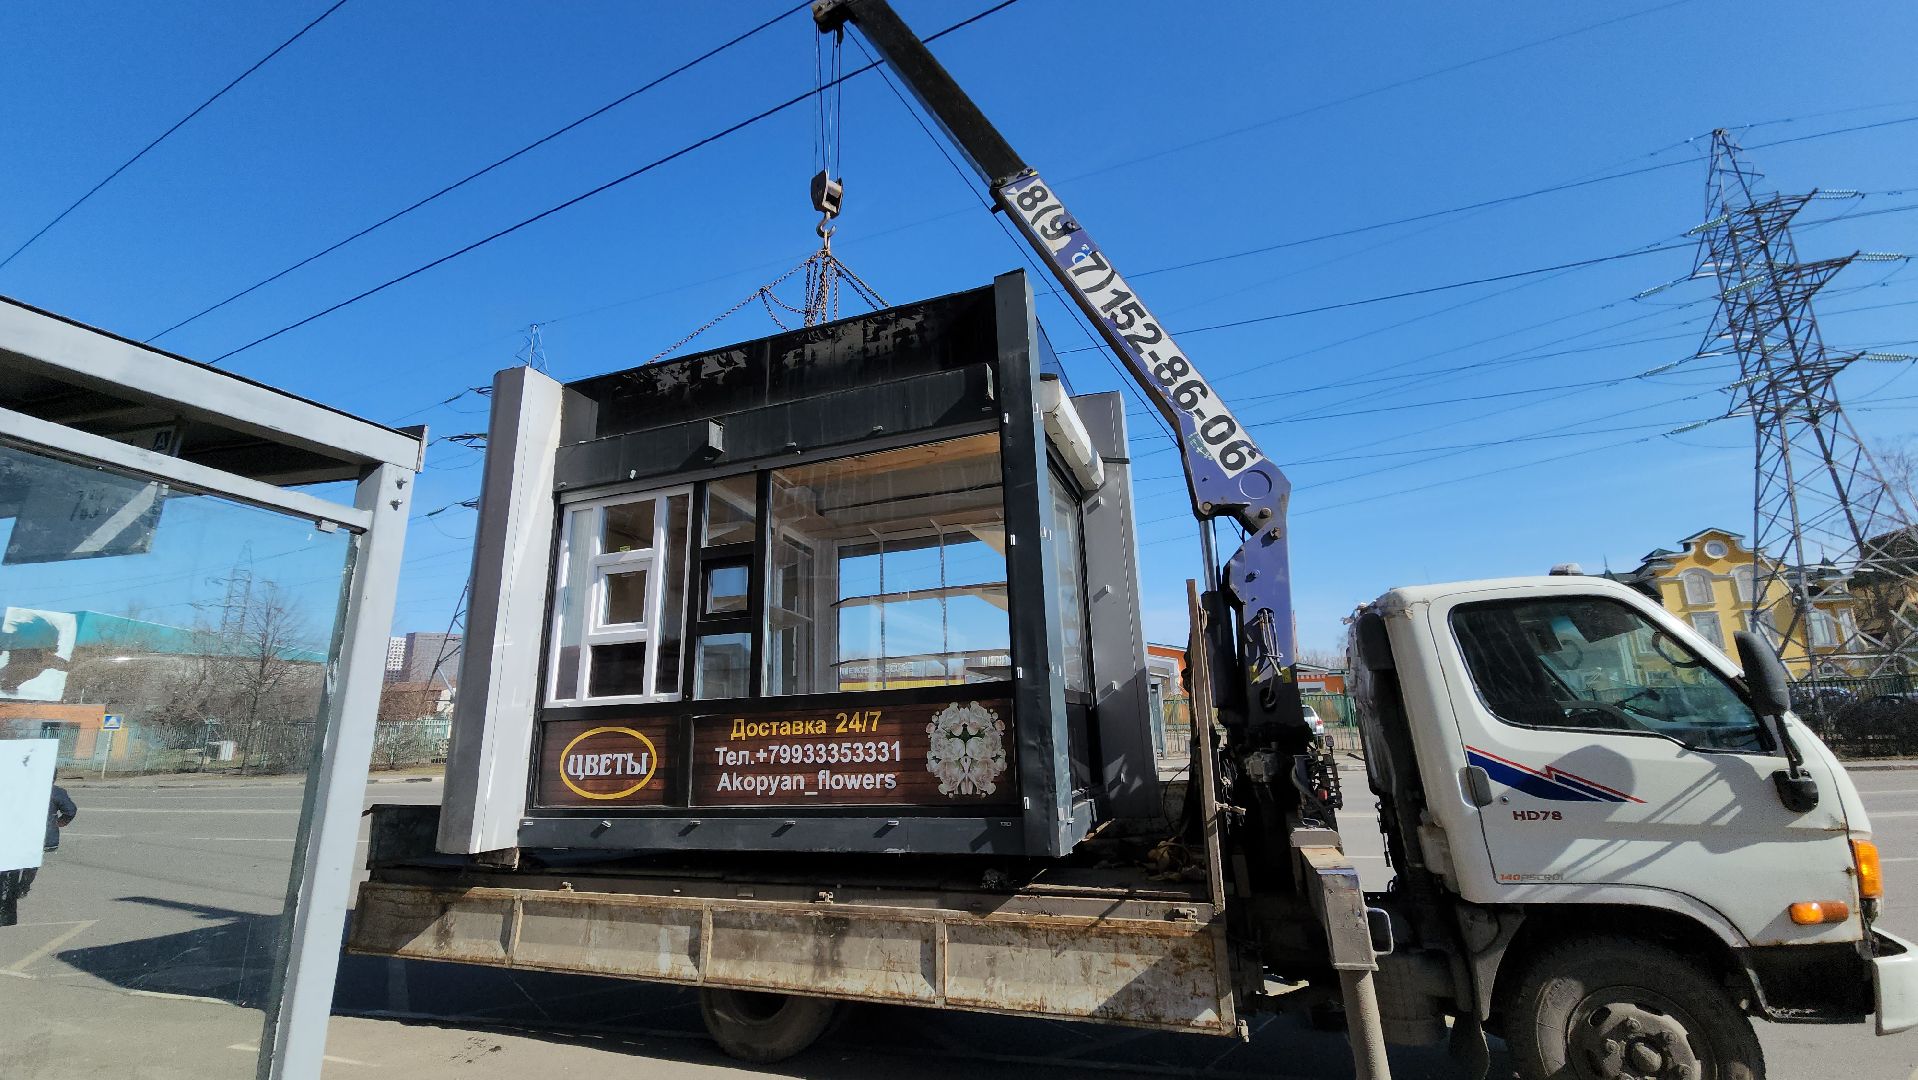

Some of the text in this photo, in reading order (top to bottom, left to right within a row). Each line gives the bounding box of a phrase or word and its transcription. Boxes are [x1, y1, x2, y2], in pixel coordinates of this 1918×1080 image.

[1016, 185, 1257, 471] 8(97)152-86-06
[730, 711, 882, 741] Доставка 24/7
[567, 752, 649, 781] ЦВЕТЫ
[715, 740, 901, 766] Тел.+79933353331
[716, 769, 897, 796] Akopyan_flowers
[1512, 810, 1563, 821] HD78
